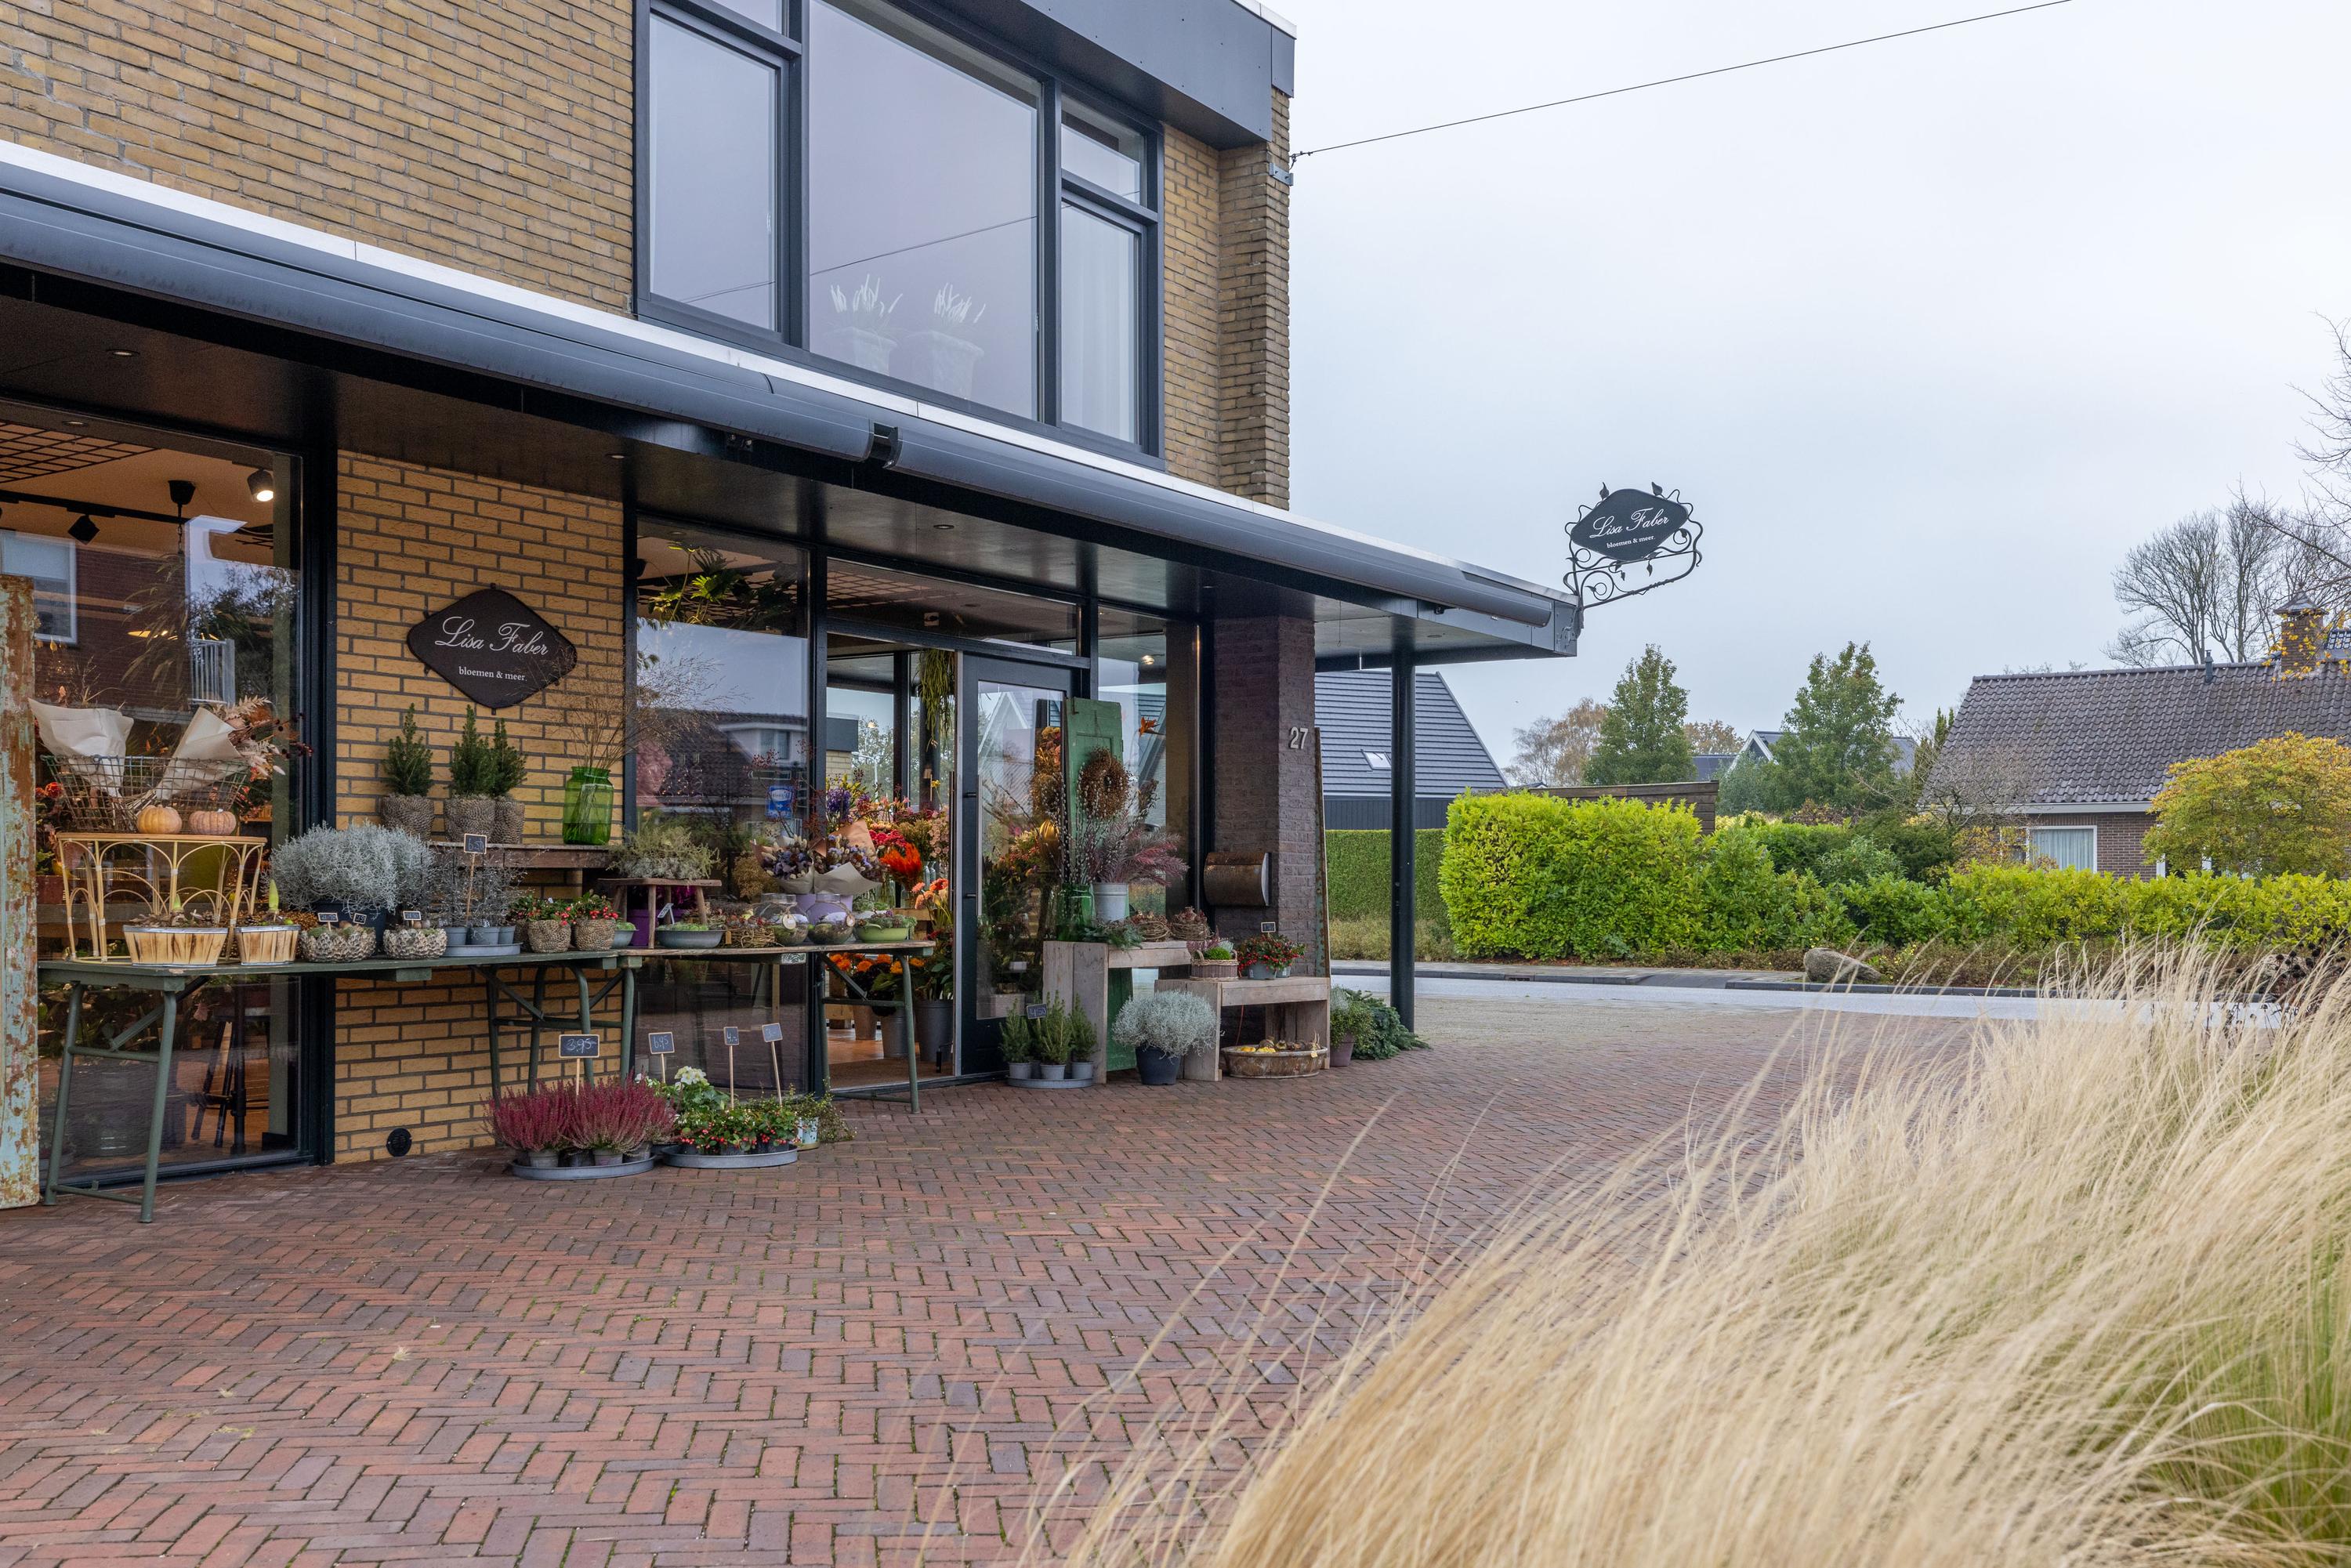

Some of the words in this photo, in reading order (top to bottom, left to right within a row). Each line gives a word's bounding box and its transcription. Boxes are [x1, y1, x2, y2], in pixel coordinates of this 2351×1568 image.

[1589, 516, 1622, 538] Lisa
[1626, 507, 1669, 531] Faber
[435, 616, 484, 649] Lisa
[490, 622, 549, 655] Faber
[458, 666, 494, 678] bloemen
[505, 673, 527, 682] meer.
[1290, 726, 1309, 749] 27
